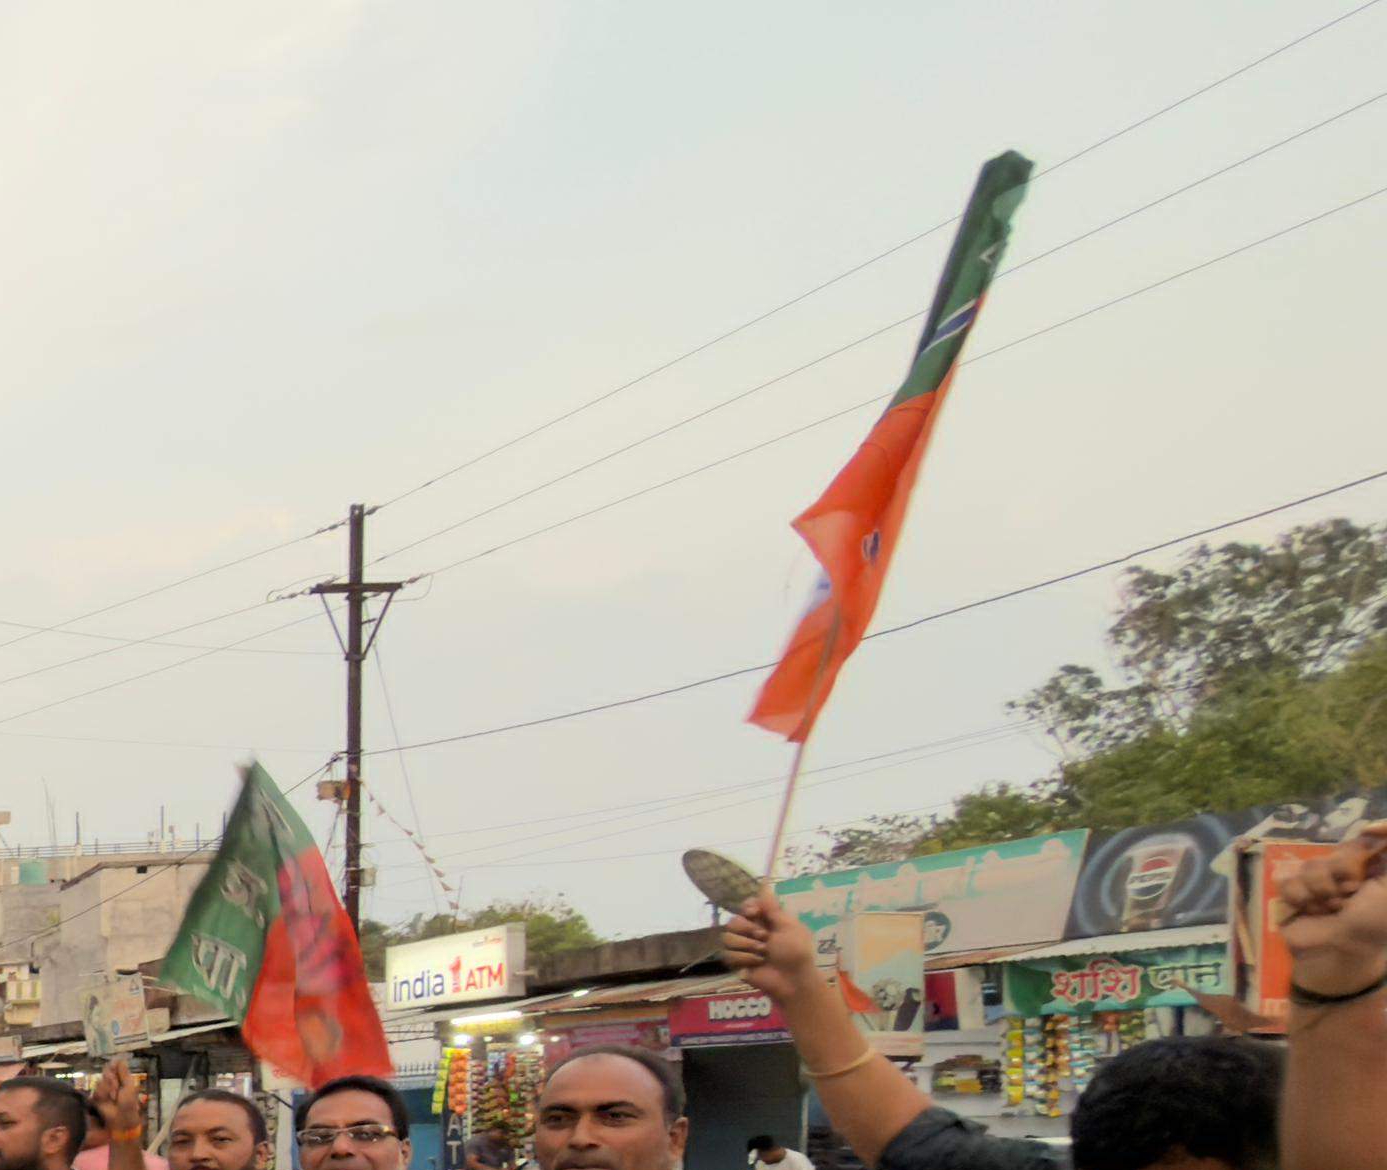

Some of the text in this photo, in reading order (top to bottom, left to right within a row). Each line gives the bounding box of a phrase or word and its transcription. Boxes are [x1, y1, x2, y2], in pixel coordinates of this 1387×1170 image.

[393, 970, 445, 1003] india
[465, 962, 505, 992] ATM
[708, 996, 772, 1021] HOCCO
